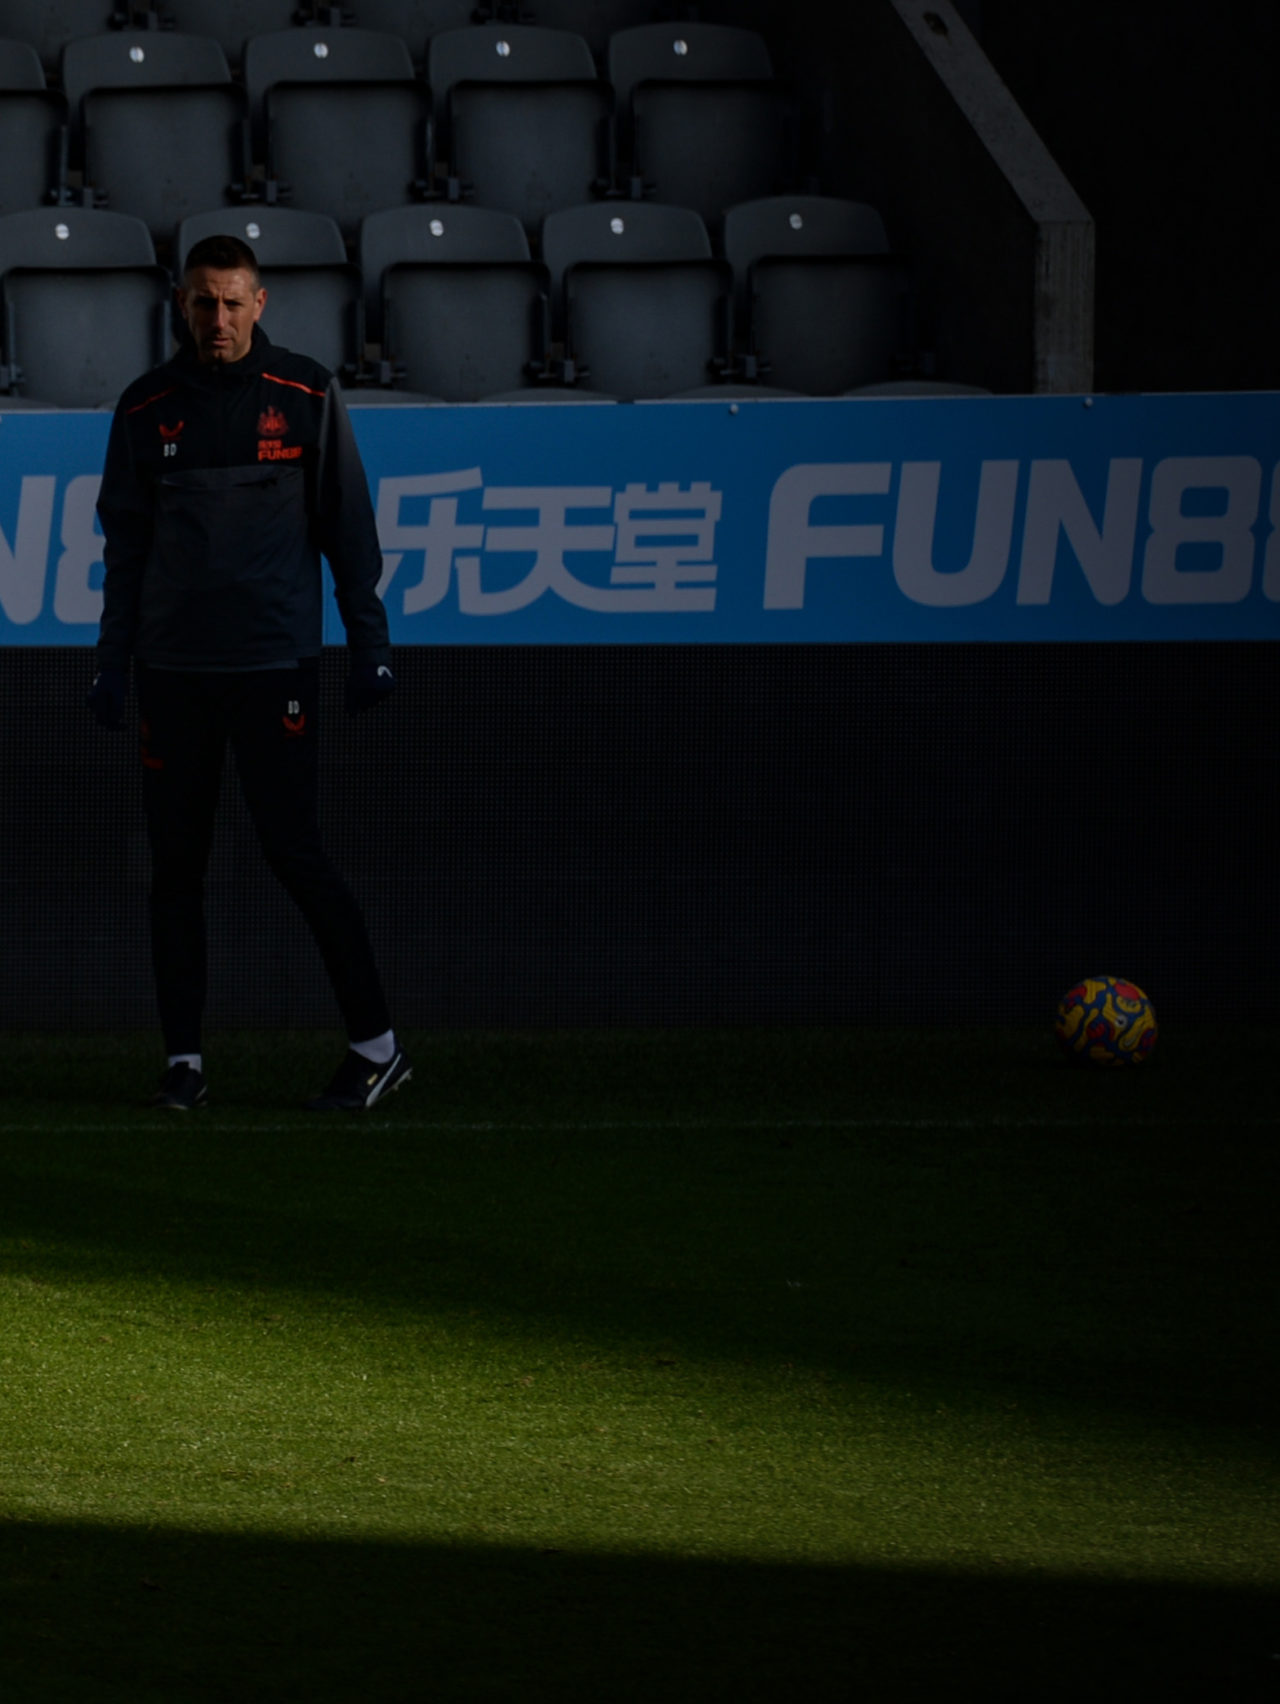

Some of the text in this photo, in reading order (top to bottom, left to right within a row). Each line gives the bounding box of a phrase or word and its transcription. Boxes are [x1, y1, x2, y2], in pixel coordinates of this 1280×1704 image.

[375, 466, 722, 615] 乐天堂
[762, 455, 1280, 610] FUN8
